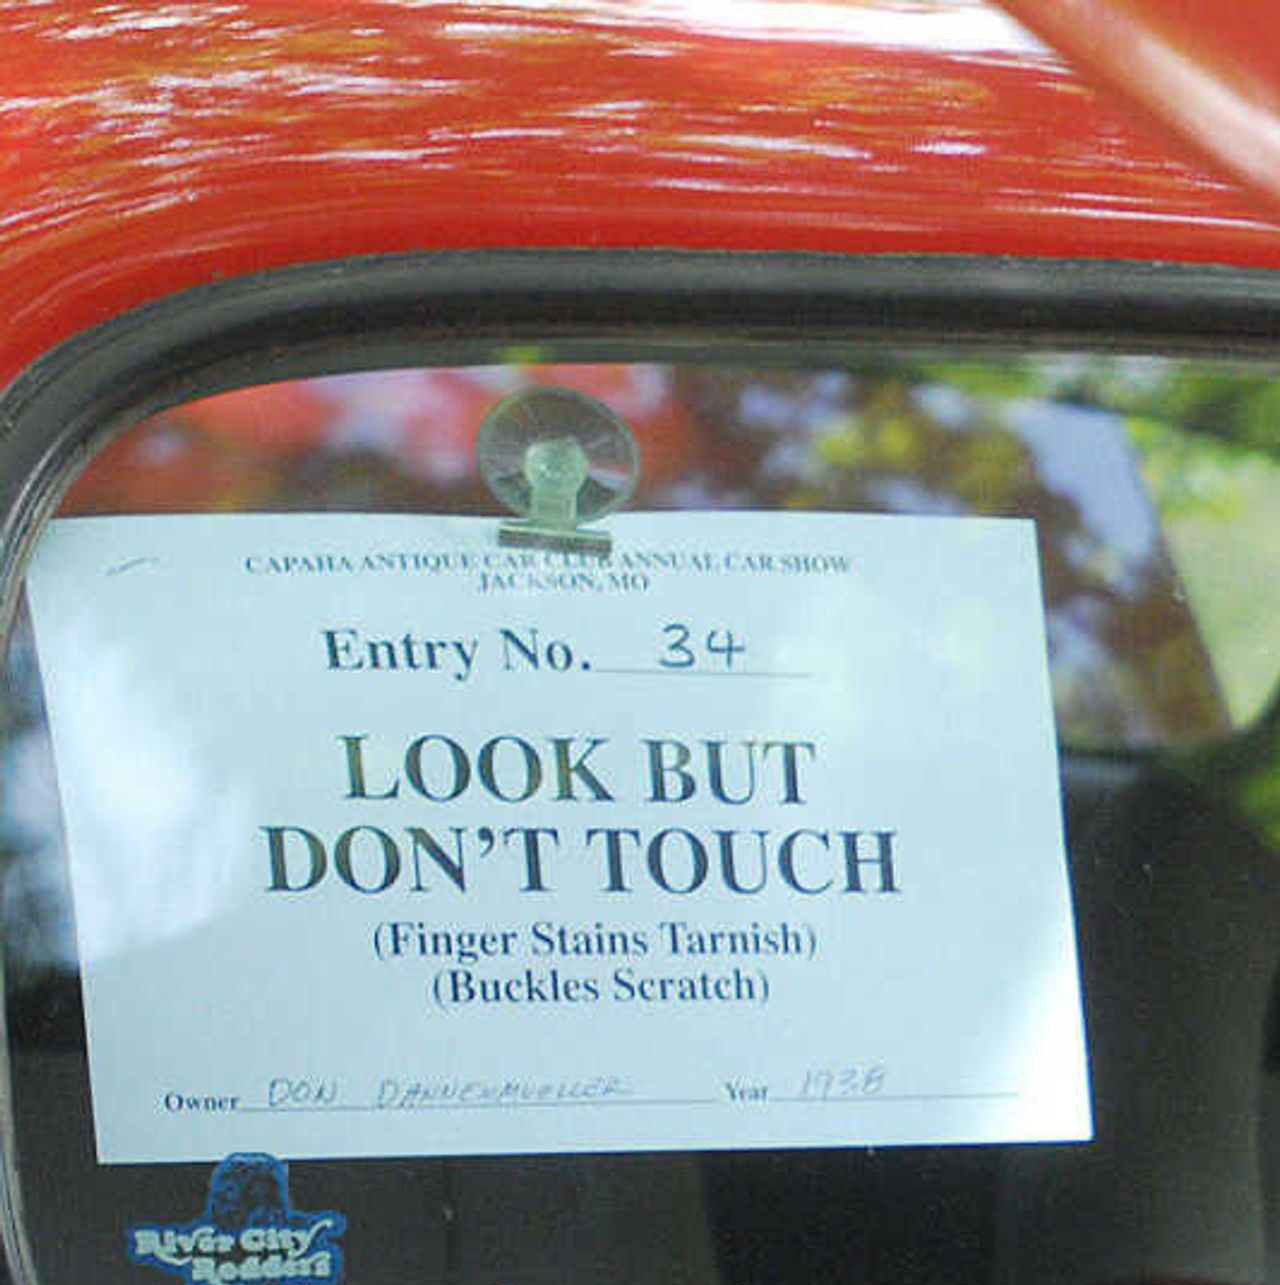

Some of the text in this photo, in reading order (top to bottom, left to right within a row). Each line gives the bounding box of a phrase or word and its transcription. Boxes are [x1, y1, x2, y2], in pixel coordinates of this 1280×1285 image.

[361, 553, 470, 573] ANTIQUE
[482, 554, 538, 573] CAR
[619, 553, 720, 573] ANNUAL
[723, 554, 777, 573] CAR
[782, 555, 852, 575] SHOW
[322, 628, 591, 682] Entry No.
[657, 623, 746, 670] 34
[337, 733, 817, 806] LOOK BUT
[259, 824, 902, 896] DON'T TOUCH
[373, 921, 817, 961] (Finger Stains Tarnish)
[432, 968, 771, 1011] (Buckles Scratch)
[163, 1091, 239, 1114] Owner
[267, 1075, 338, 1108] DON
[724, 1081, 770, 1103] Year
[799, 1063, 887, 1101] 1938
[239, 1218, 334, 1262] City
